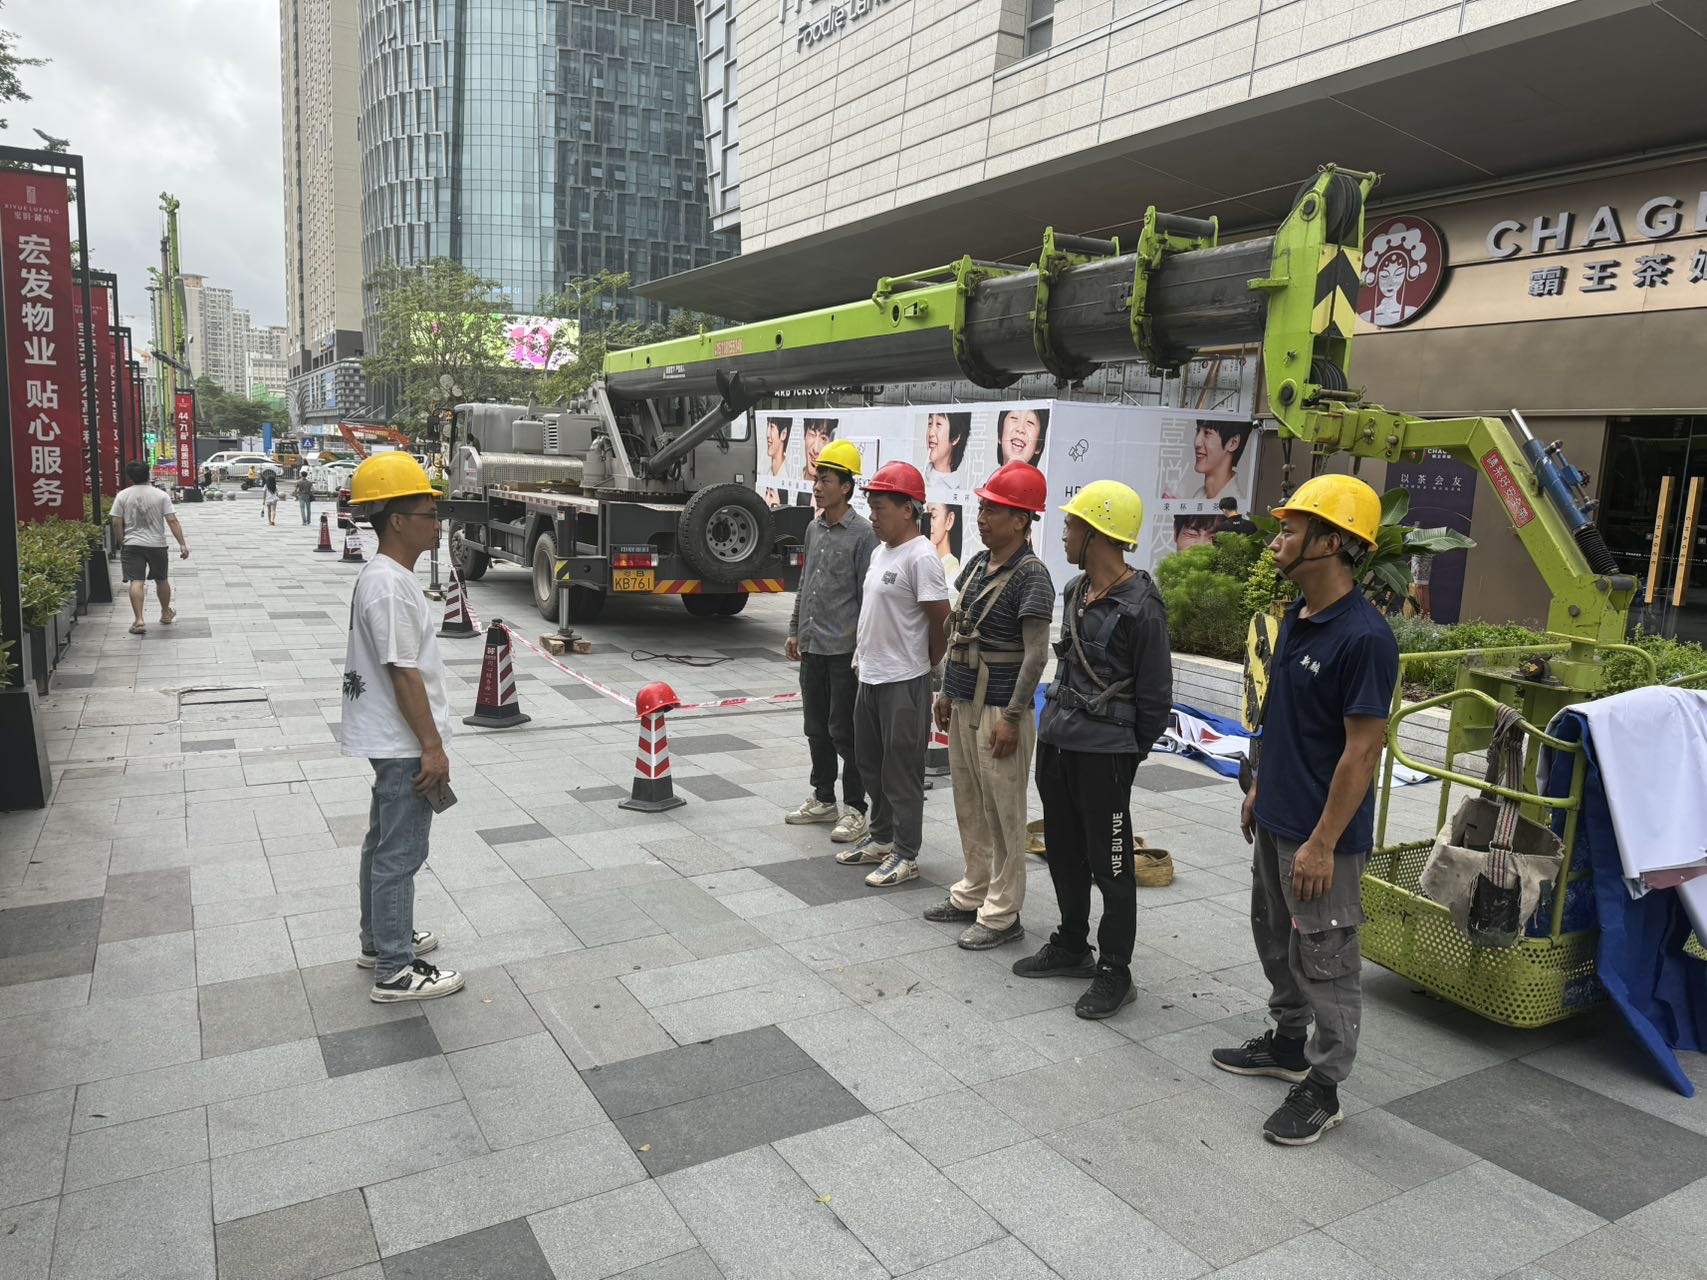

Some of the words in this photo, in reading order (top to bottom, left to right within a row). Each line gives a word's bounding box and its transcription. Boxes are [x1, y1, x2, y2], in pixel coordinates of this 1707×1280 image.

[796, 5, 848, 53] Foodie
[18, 234, 57, 366] 宏发物业
[26, 379, 64, 507] 贴心服务
[1401, 474, 1463, 487] 以茶会友
[1651, 514, 1663, 566] CHAGEE
[1679, 516, 1691, 567] CHAGEE
[615, 577, 651, 590] KB761
[1113, 812, 1123, 835] YUE
[1112, 838, 1123, 851] BU
[1112, 854, 1123, 877] YUE
